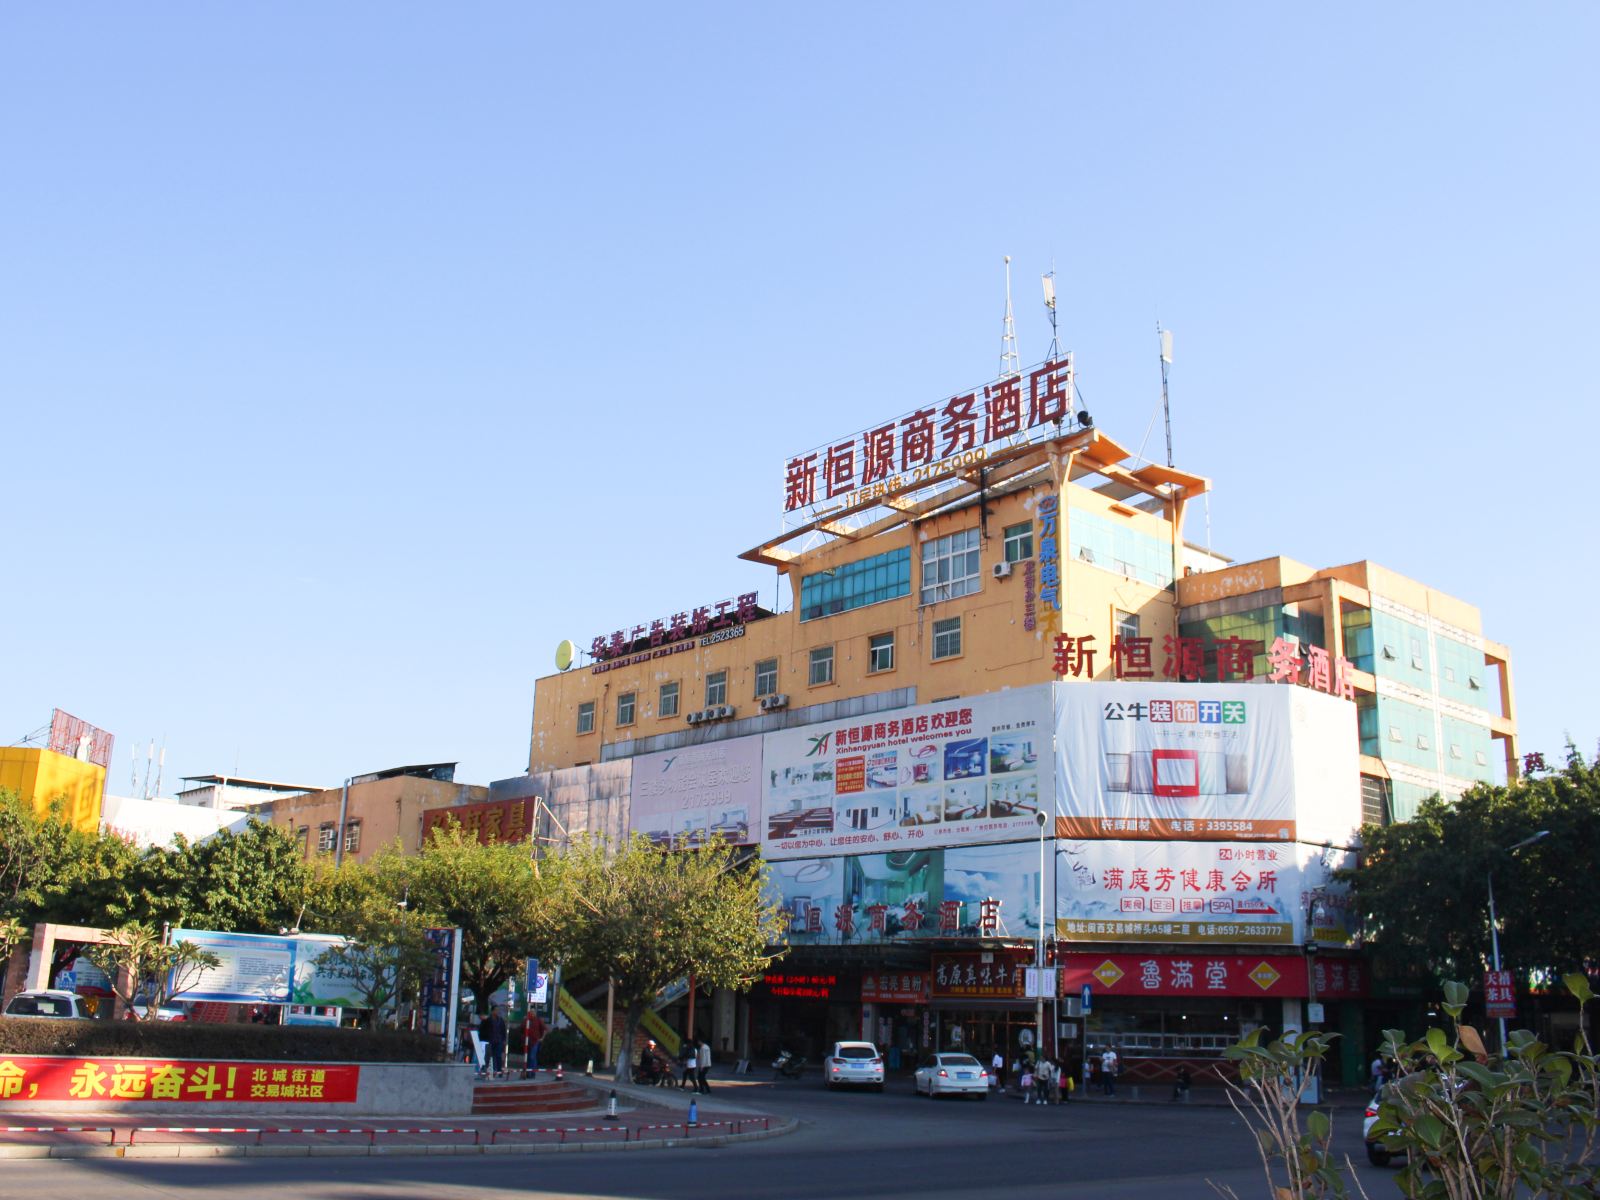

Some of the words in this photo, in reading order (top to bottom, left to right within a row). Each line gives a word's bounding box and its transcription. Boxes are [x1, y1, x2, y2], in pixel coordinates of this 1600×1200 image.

[785, 359, 1070, 510] 新恒源商务酒店
[1039, 512, 1062, 610] 万泉电气
[1052, 632, 1355, 699] 新恒源商务酒店
[1104, 700, 1246, 723] 公牛装饰开关
[835, 714, 928, 746] 新恒源商务酒店
[931, 708, 973, 730] 欢迎您
[836, 741, 886, 754] Xinhengyuan
[888, 737, 909, 746] hotel
[911, 731, 953, 743] welcomes
[955, 728, 972, 738] you
[1219, 849, 1278, 861] 24小时营业
[1103, 867, 1278, 893] 满庭芳健康会所
[1122, 899, 1142, 910] 美食
[1213, 901, 1231, 911] SPA
[902, 976, 922, 991] 鱼粉
[252, 1068, 327, 1082] 北城街道
[250, 1084, 323, 1098] 交易城社区
